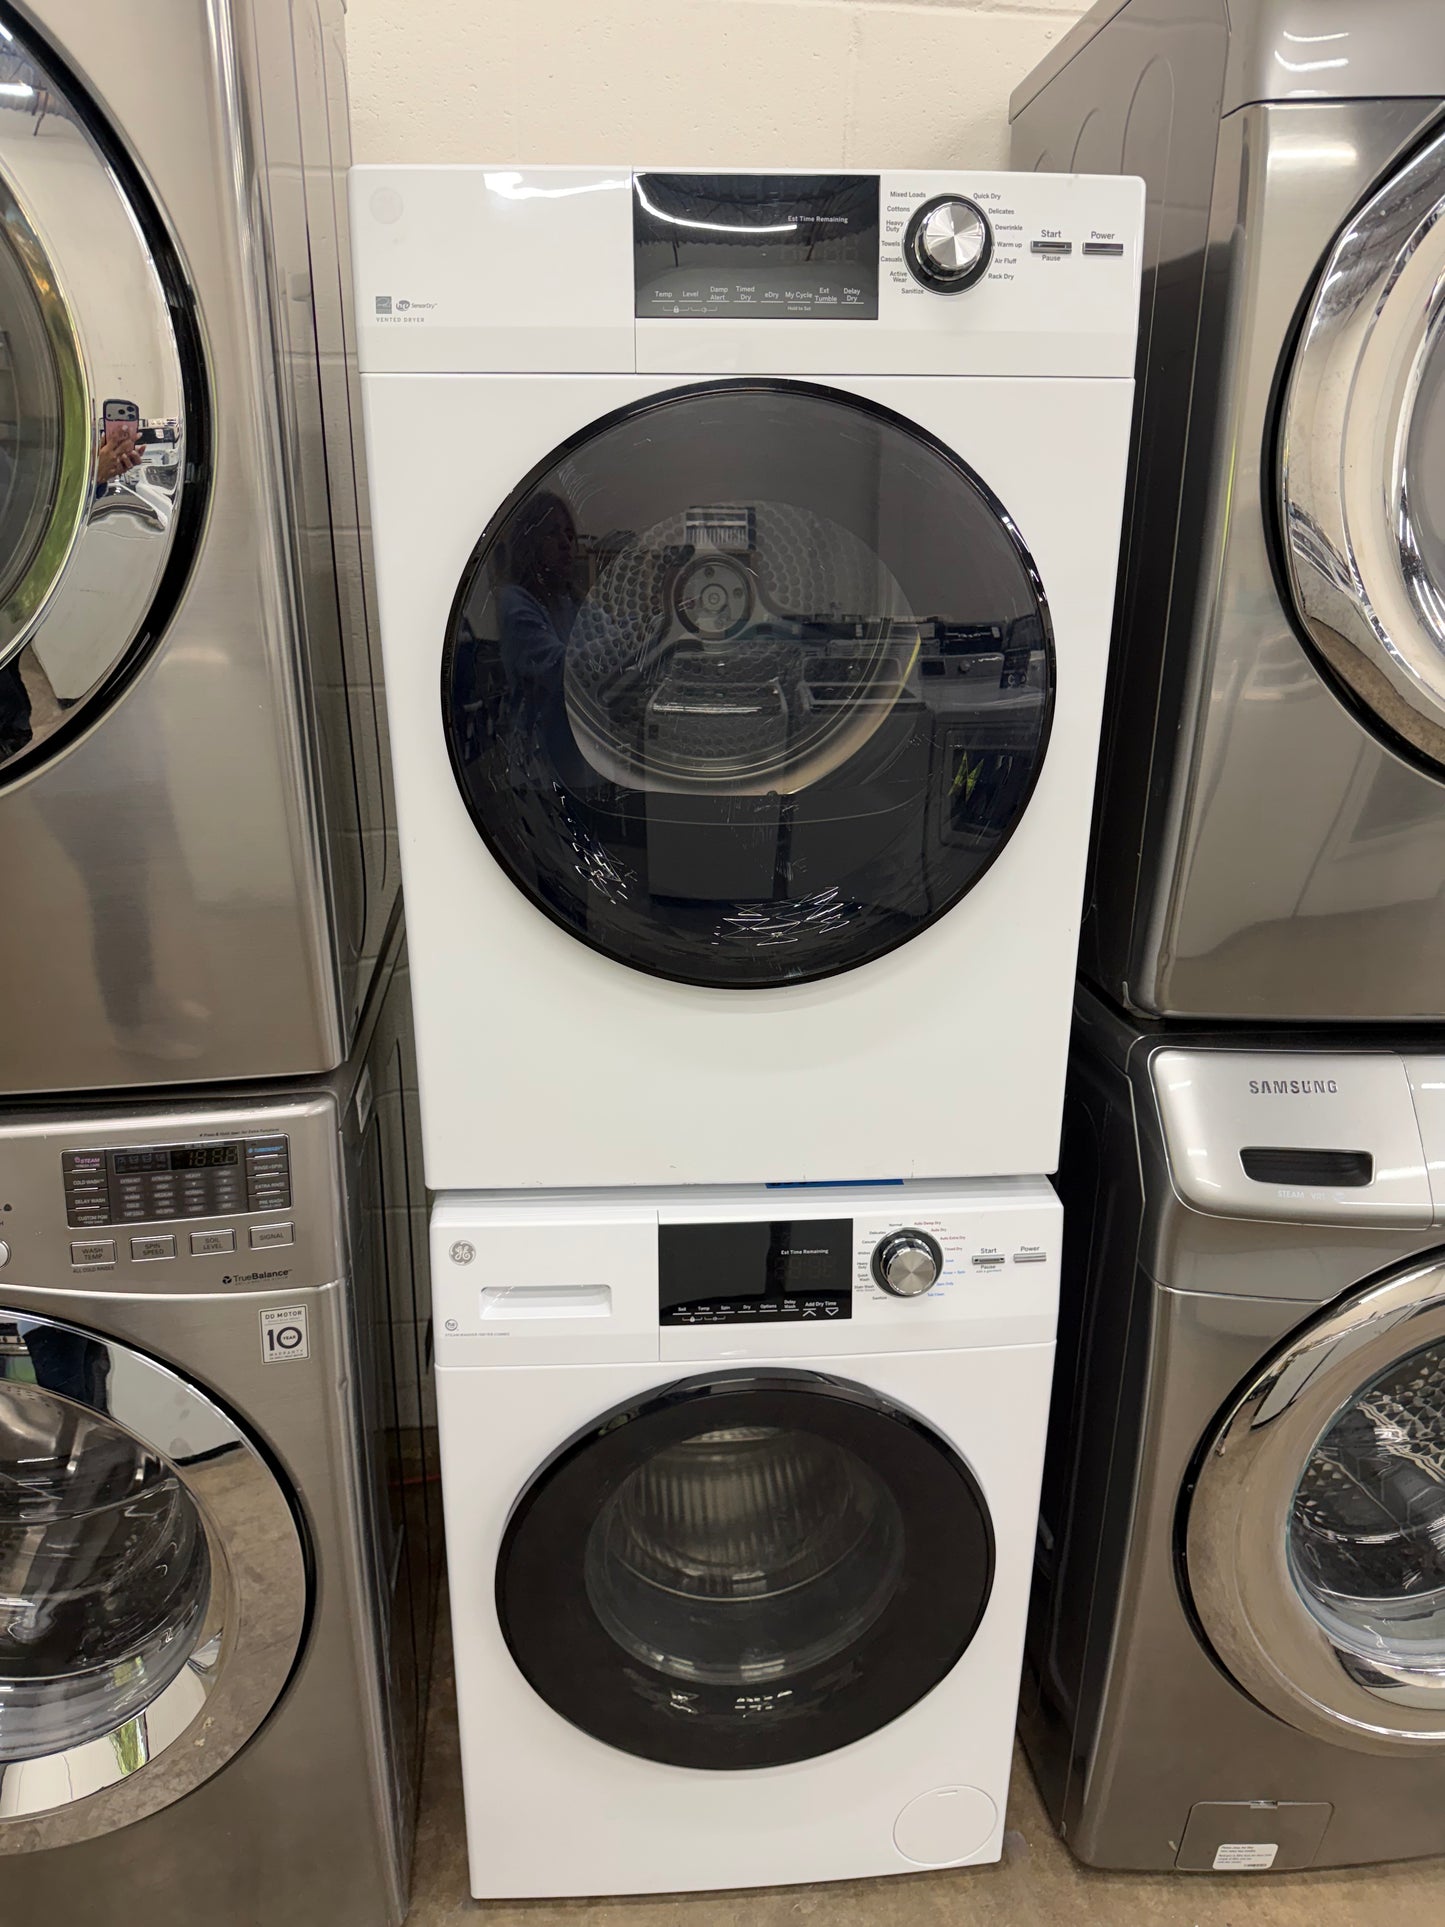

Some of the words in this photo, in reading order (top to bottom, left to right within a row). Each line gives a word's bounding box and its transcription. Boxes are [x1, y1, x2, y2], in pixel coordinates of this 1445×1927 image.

[816, 216, 848, 224] Remaining
[1041, 230, 1061, 238] Start
[1091, 231, 1115, 239] Power
[1249, 1080, 1337, 1094] SAMSUNG
[1278, 1190, 1304, 1199] STEAM
[267, 1327, 302, 1351] 10
